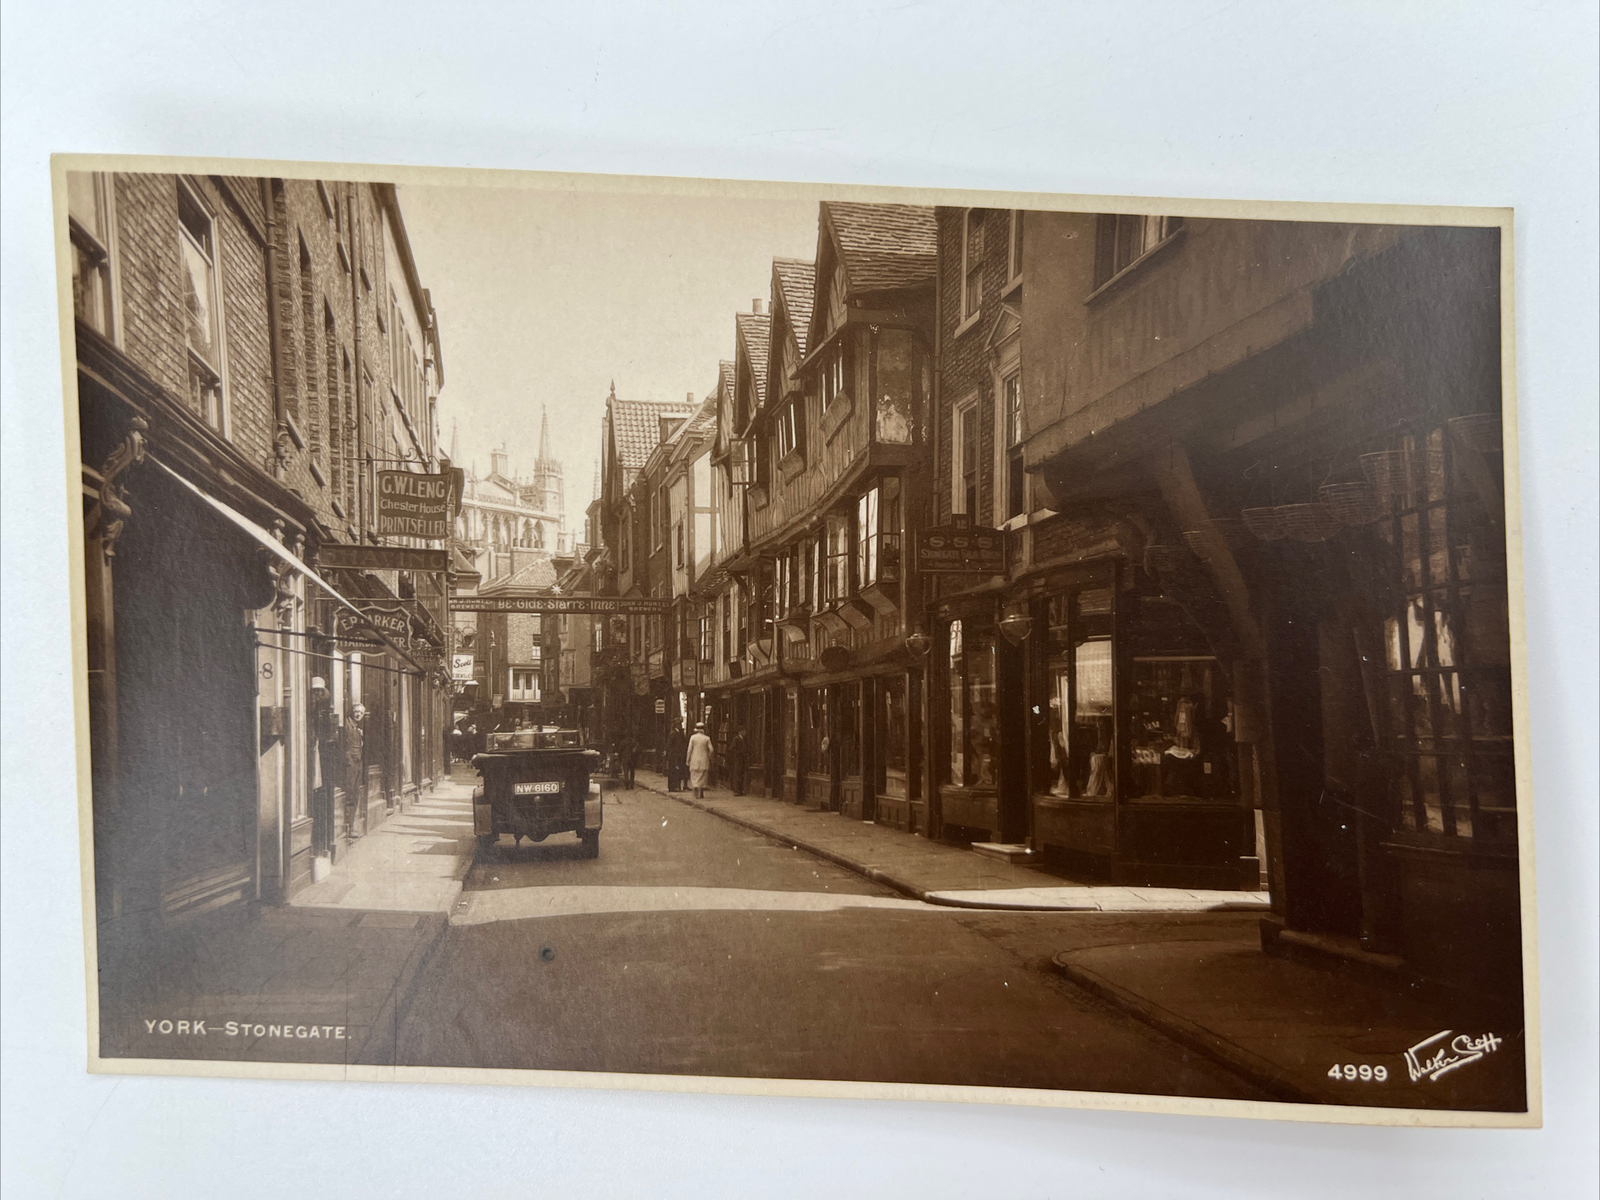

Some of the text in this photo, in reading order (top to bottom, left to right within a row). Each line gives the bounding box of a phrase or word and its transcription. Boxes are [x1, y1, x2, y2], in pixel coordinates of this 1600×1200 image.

[381, 499, 446, 513] Chester House
[380, 515, 446, 536] PRINTSELLER
[262, 662, 273, 679] 8
[1404, 1029, 1459, 1082] Walter
[1328, 1063, 1388, 1082] 4999
